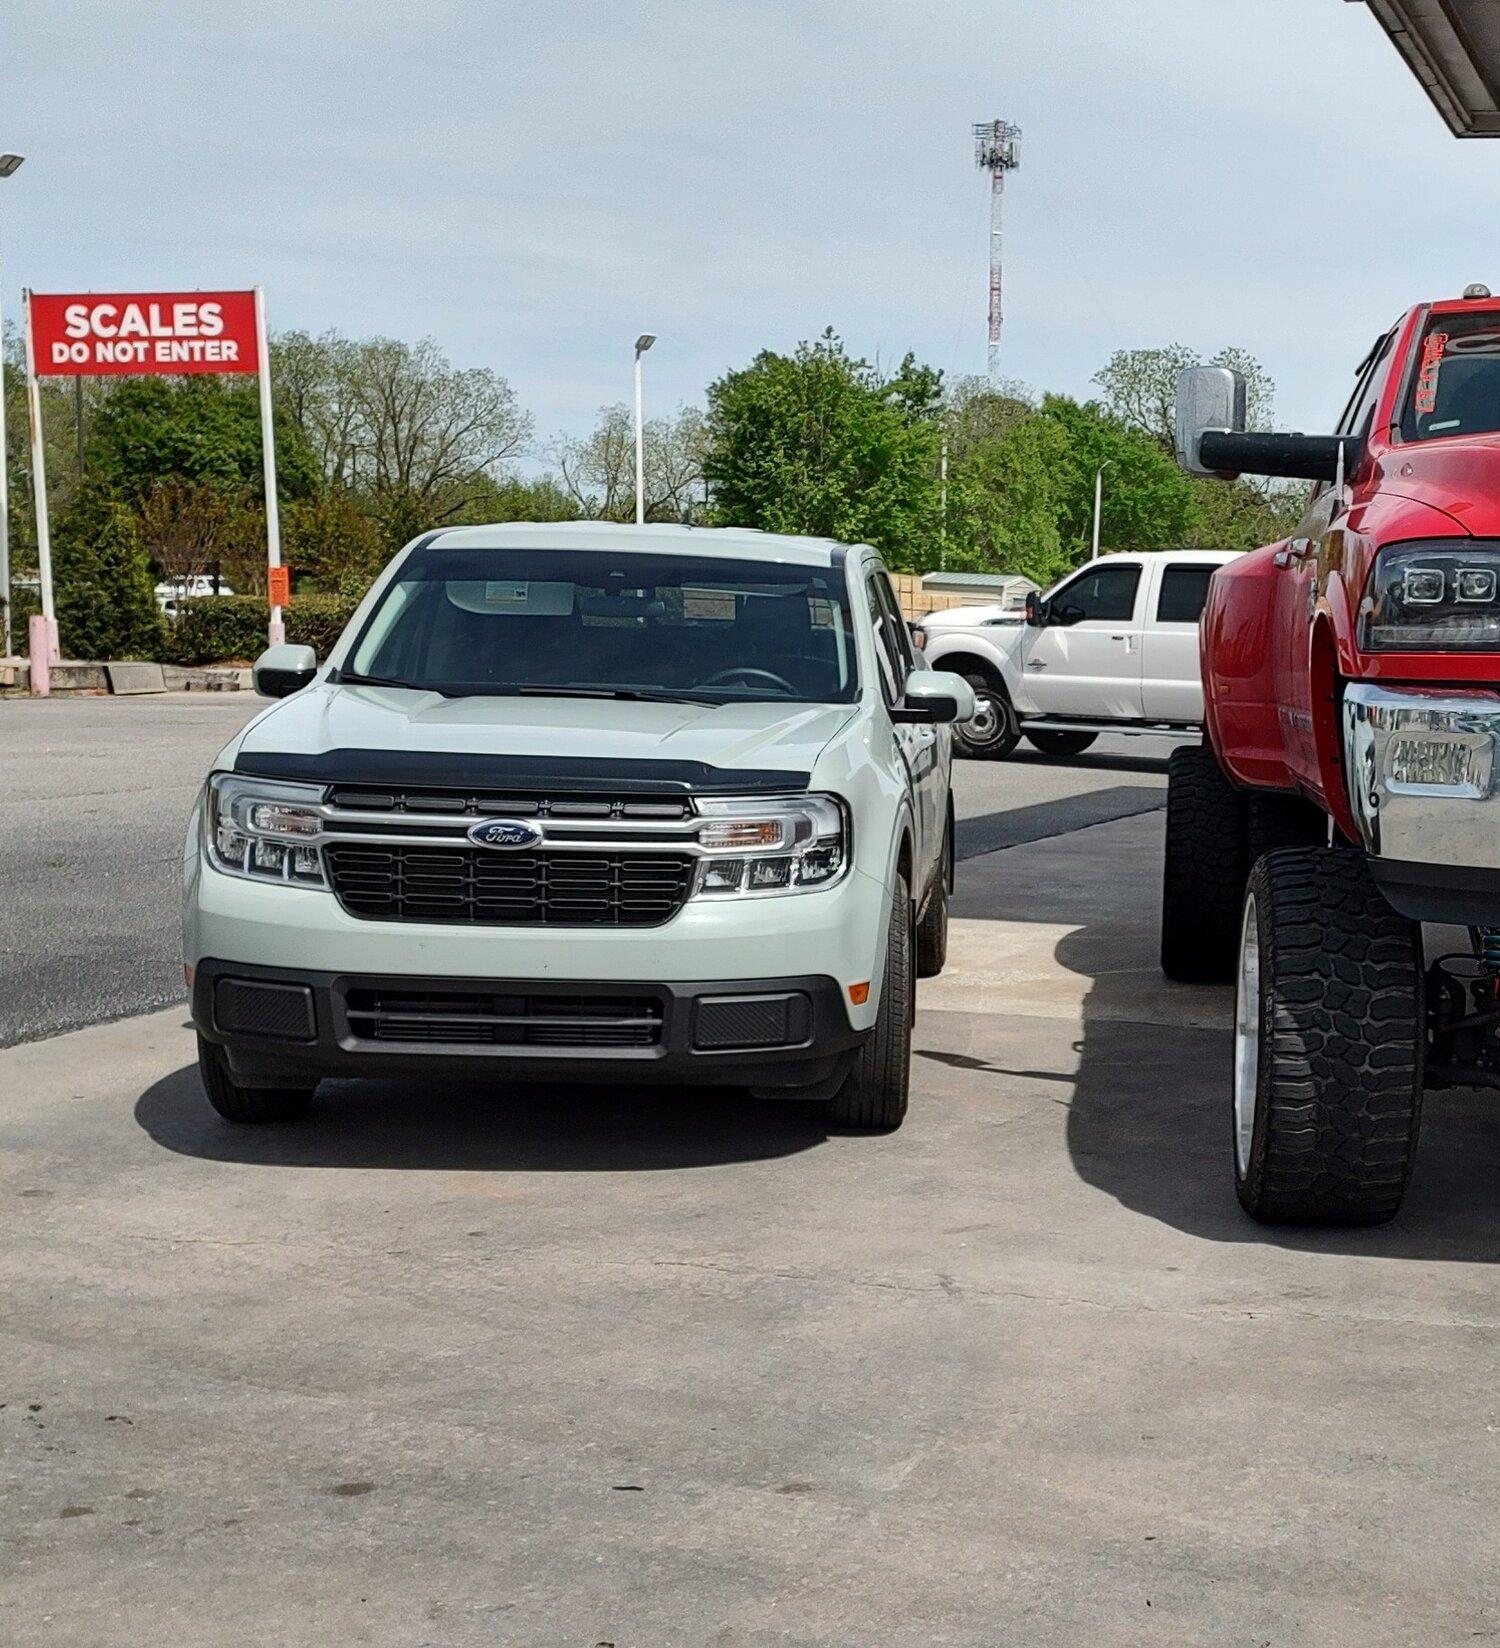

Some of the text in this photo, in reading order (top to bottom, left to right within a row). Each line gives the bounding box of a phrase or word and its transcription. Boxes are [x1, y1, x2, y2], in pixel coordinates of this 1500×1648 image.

[64, 302, 224, 338] SCALES
[51, 339, 239, 364] DO NOT ENTER
[485, 826, 525, 843] Ford
